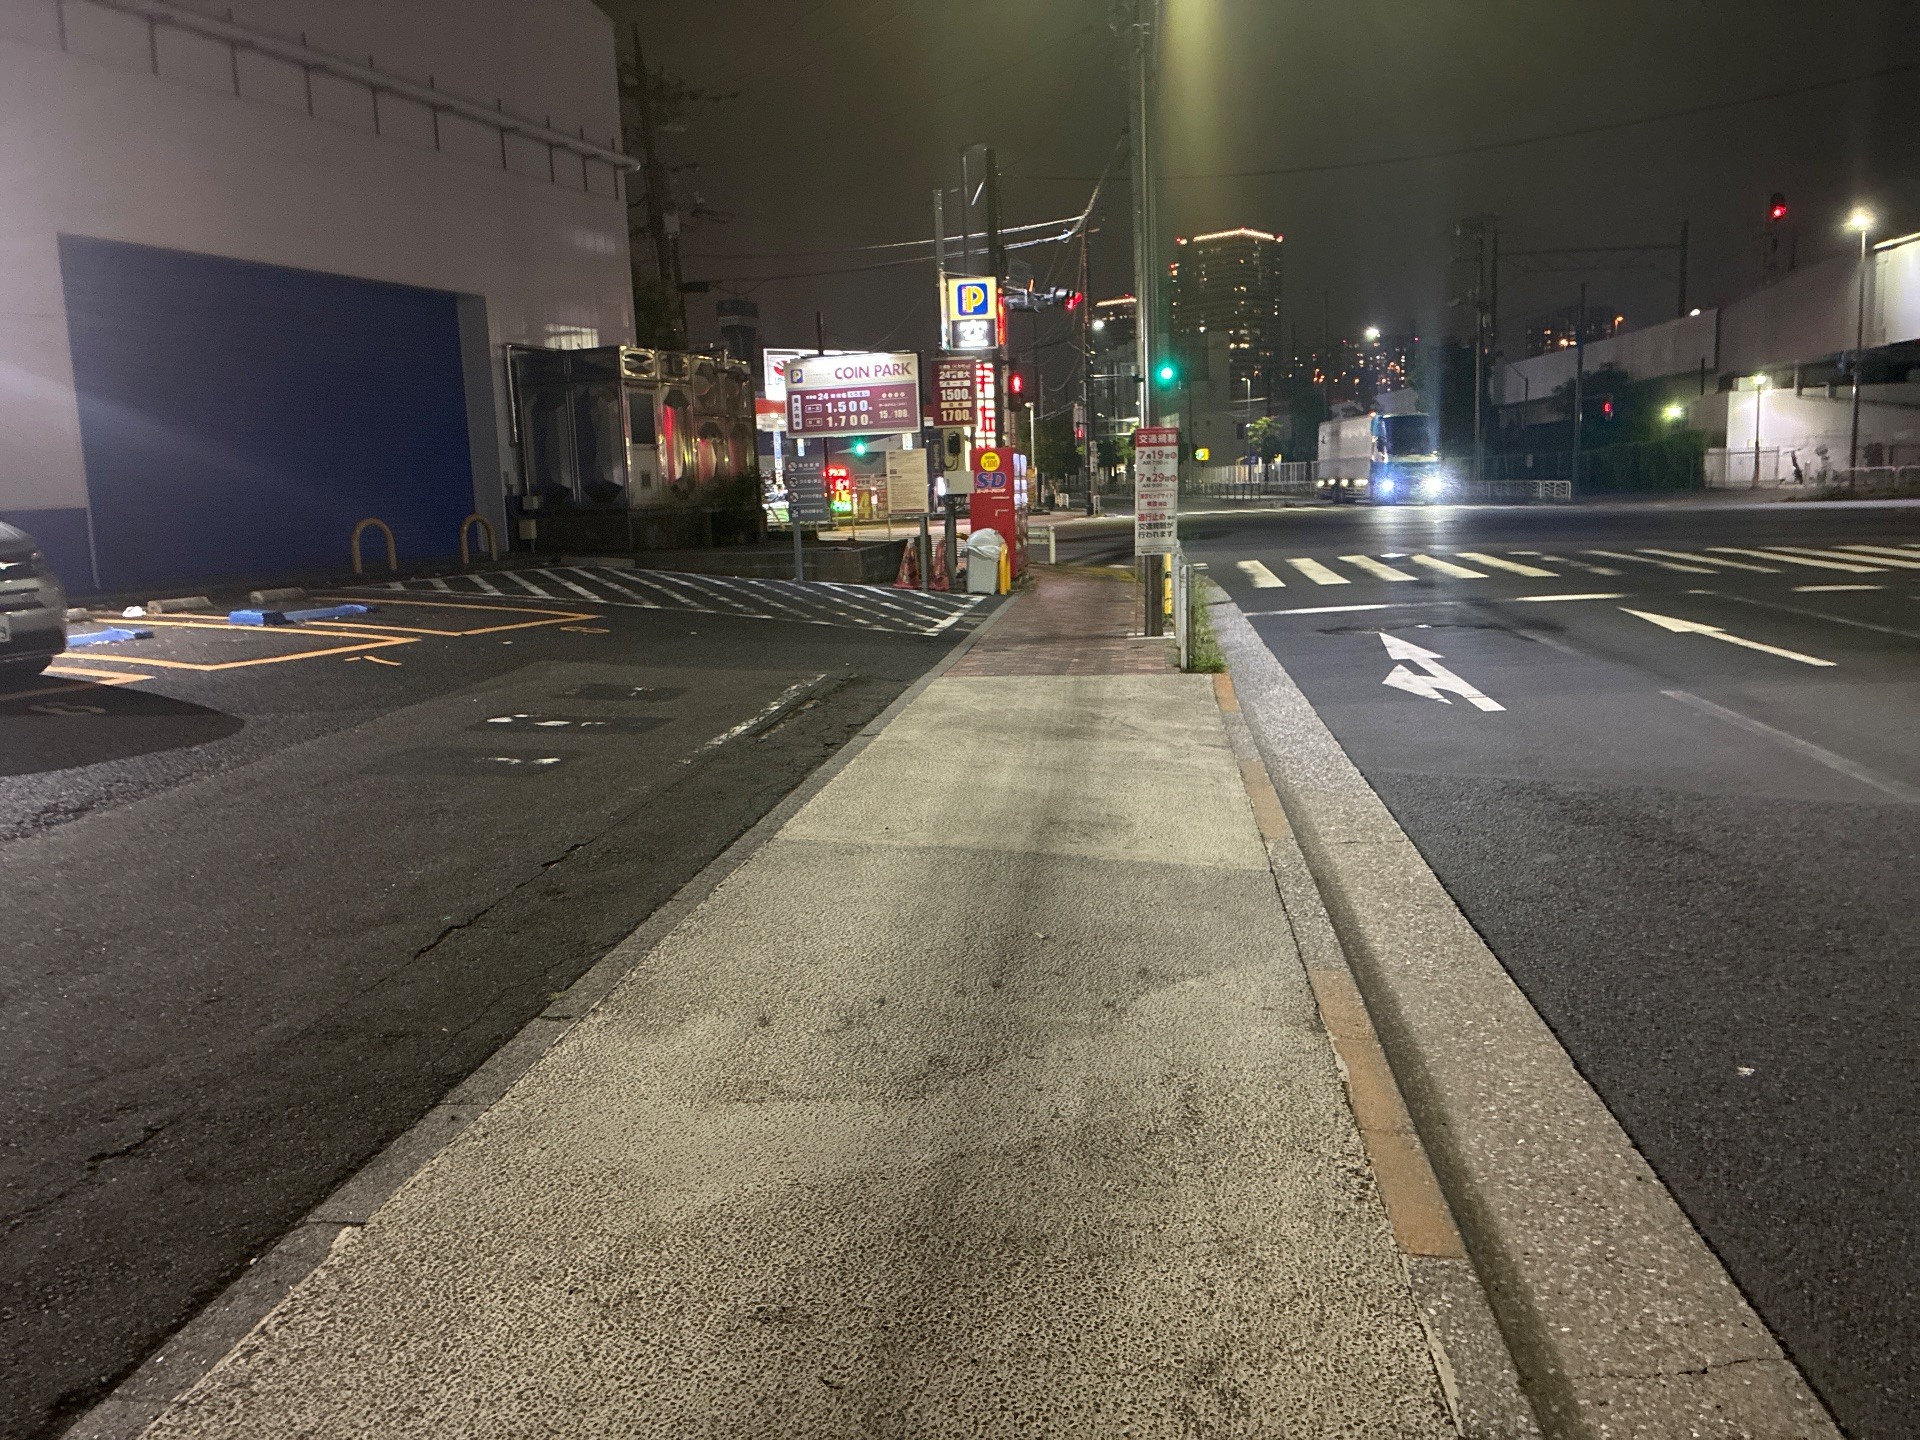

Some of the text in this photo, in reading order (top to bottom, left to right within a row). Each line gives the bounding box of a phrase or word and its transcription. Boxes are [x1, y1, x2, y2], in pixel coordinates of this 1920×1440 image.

[834, 366, 870, 380] COIN
[874, 362, 912, 377] PARK
[940, 388, 972, 401] 1500
[941, 409, 973, 422] 1700
[1138, 450, 1177, 459] 7月19日
[1138, 473, 1177, 482] 7月29日
[1138, 531, 1174, 539] 行われます
